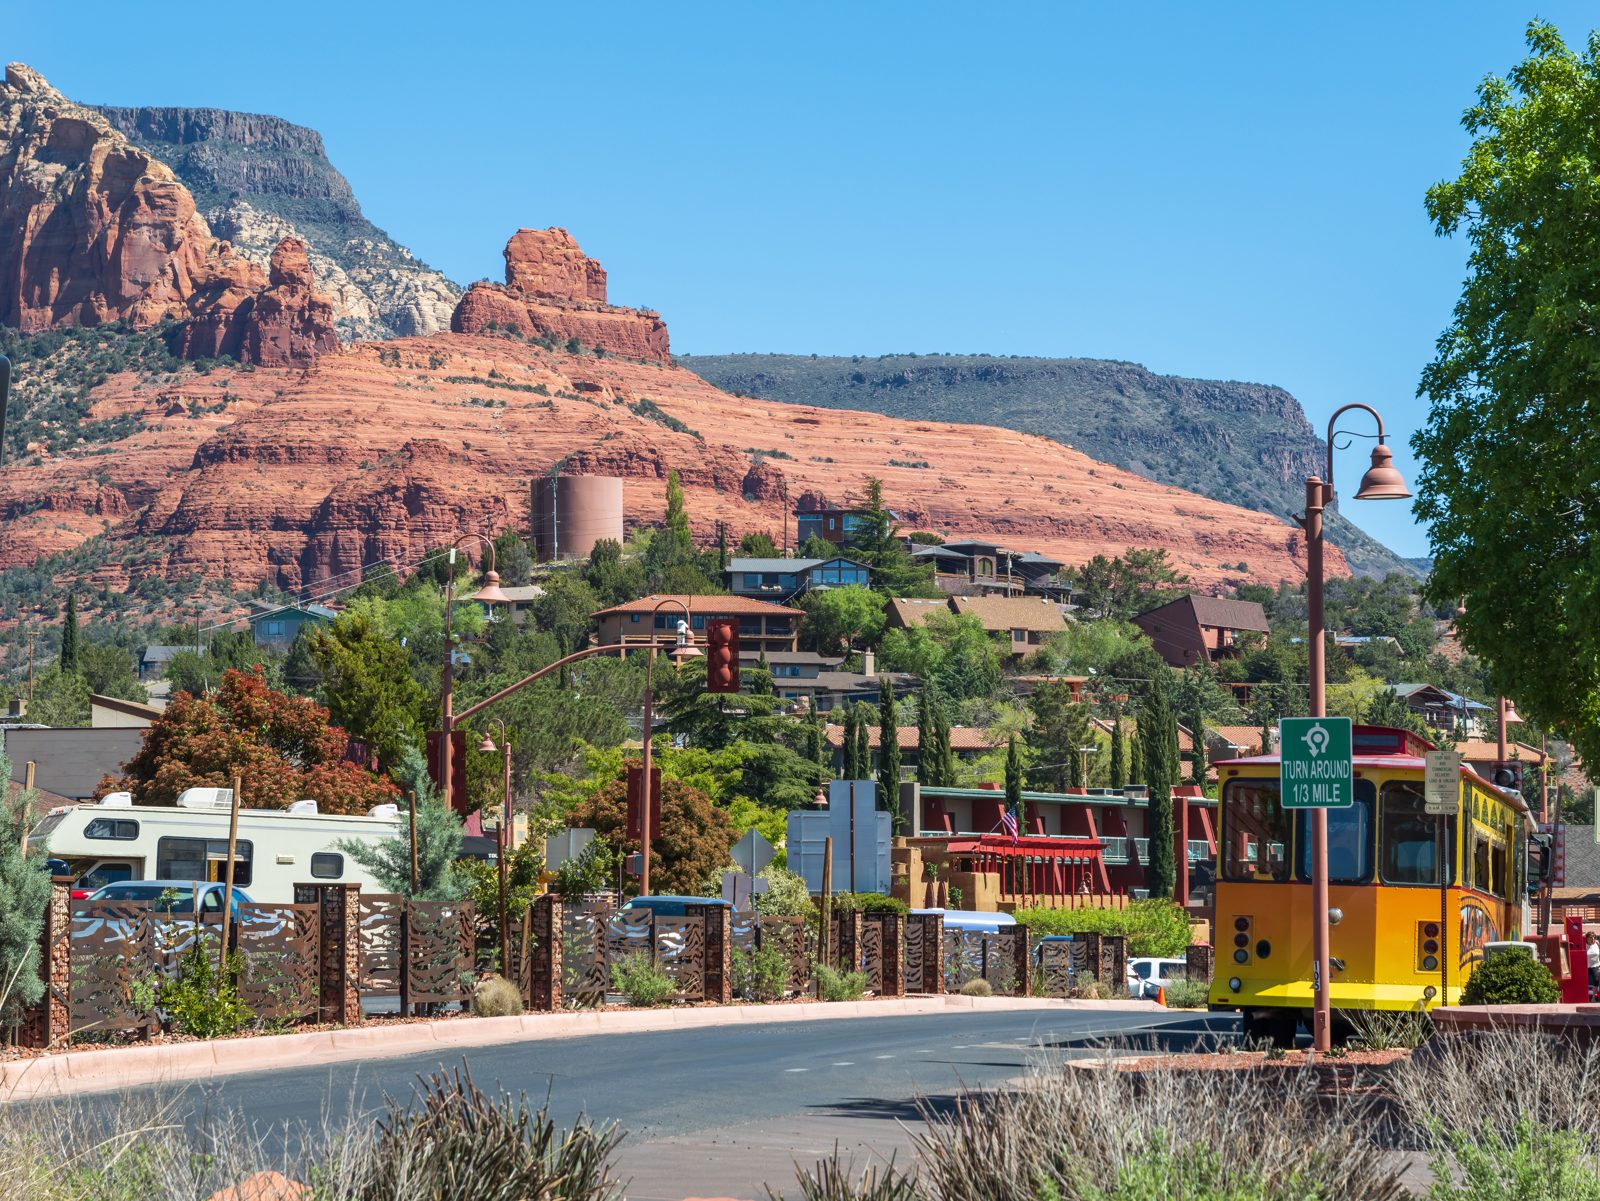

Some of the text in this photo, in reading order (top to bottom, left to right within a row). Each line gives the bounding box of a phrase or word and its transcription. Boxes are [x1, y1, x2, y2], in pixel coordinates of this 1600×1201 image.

[1284, 760, 1349, 780] TURN AROUND
[1293, 784, 1340, 803] 1/3 MILE
